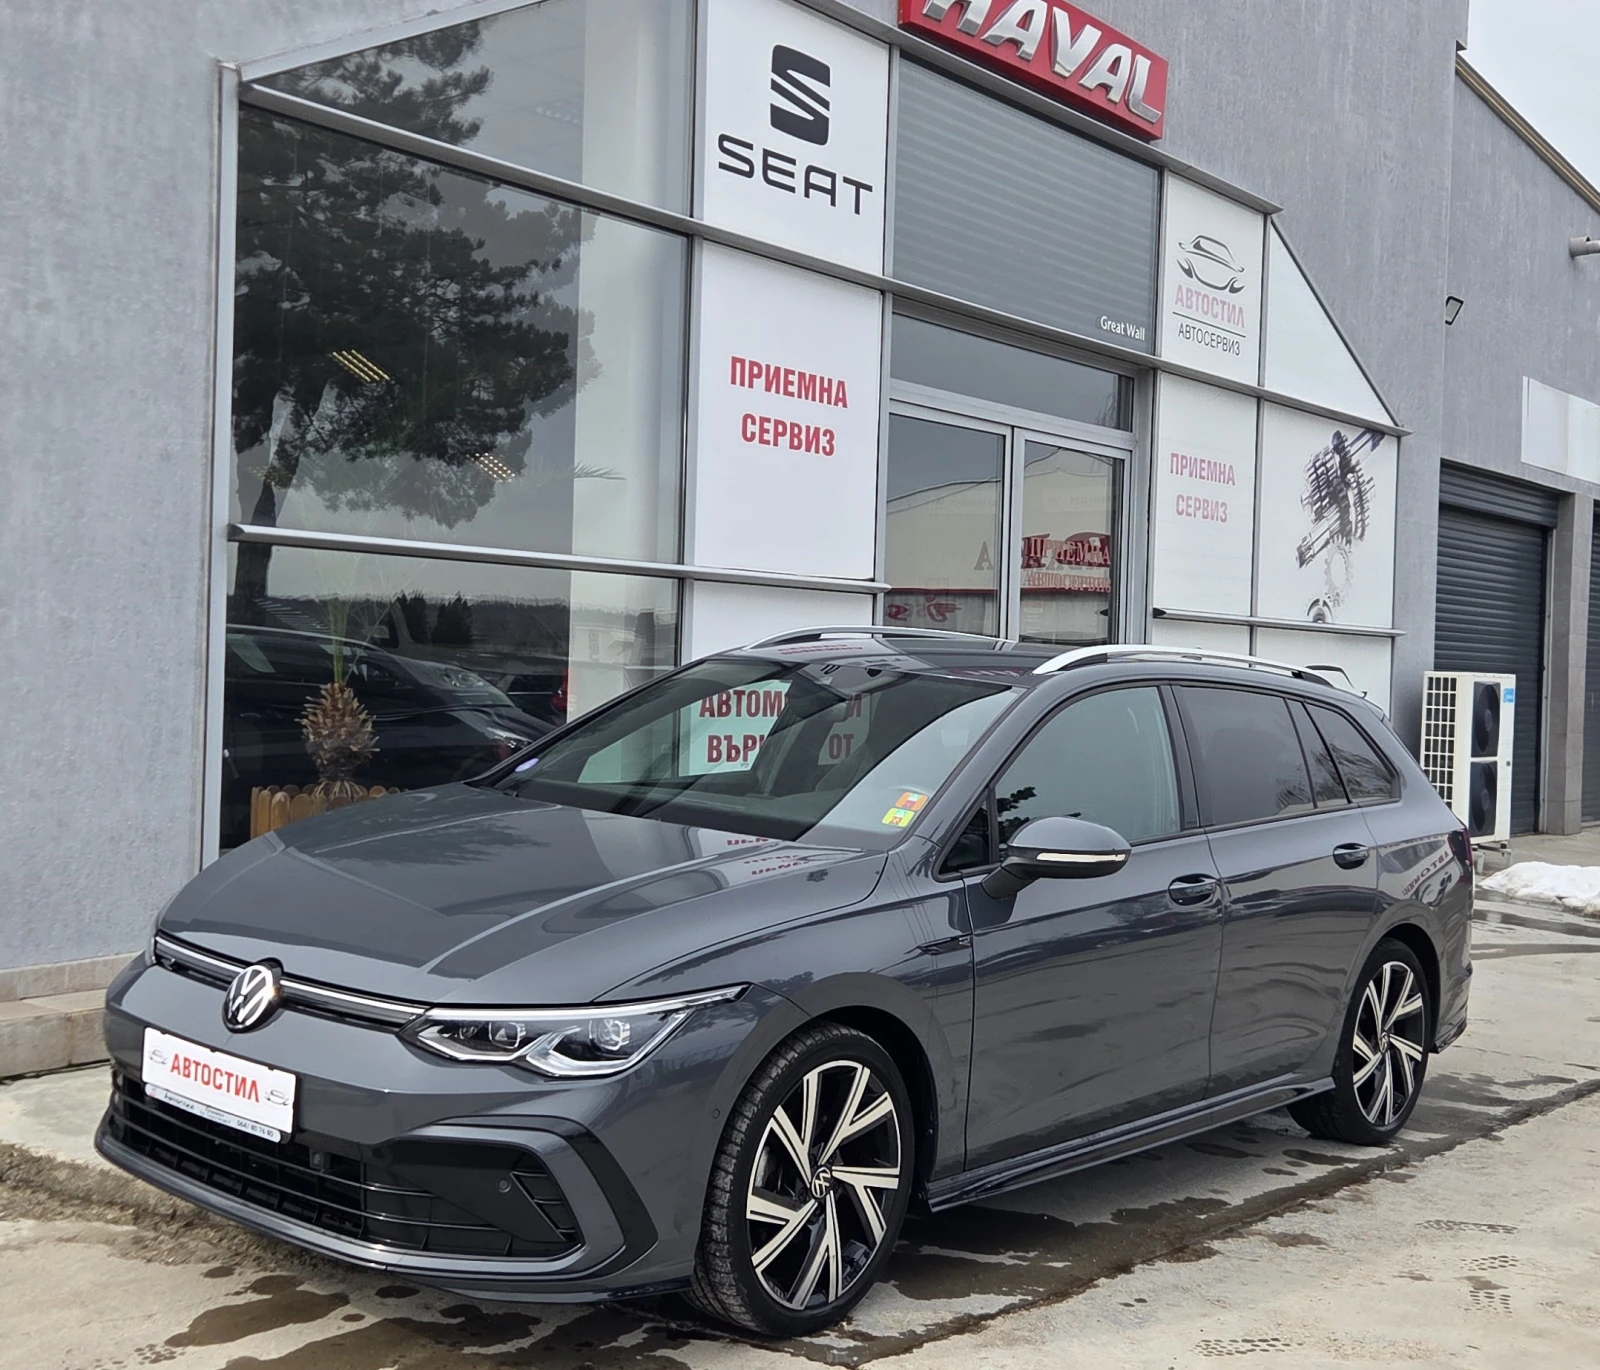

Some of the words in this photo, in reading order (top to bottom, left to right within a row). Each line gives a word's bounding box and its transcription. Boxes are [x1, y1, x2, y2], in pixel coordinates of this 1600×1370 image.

[718, 133, 873, 215] SEAT
[1100, 315, 1125, 334] Great
[1127, 322, 1146, 341] Wall
[1174, 284, 1245, 328] АВТОСТИЛ
[1177, 323, 1241, 356] АВТОСЕРВИЗ
[730, 355, 848, 409] ПРИЕМНА
[741, 413, 835, 457] СЕРВИЗ
[1170, 453, 1235, 486] ПРИЕМНА
[1176, 494, 1228, 523] СЕРВИЗ
[169, 1053, 260, 1103] АВТОСТИЛ
